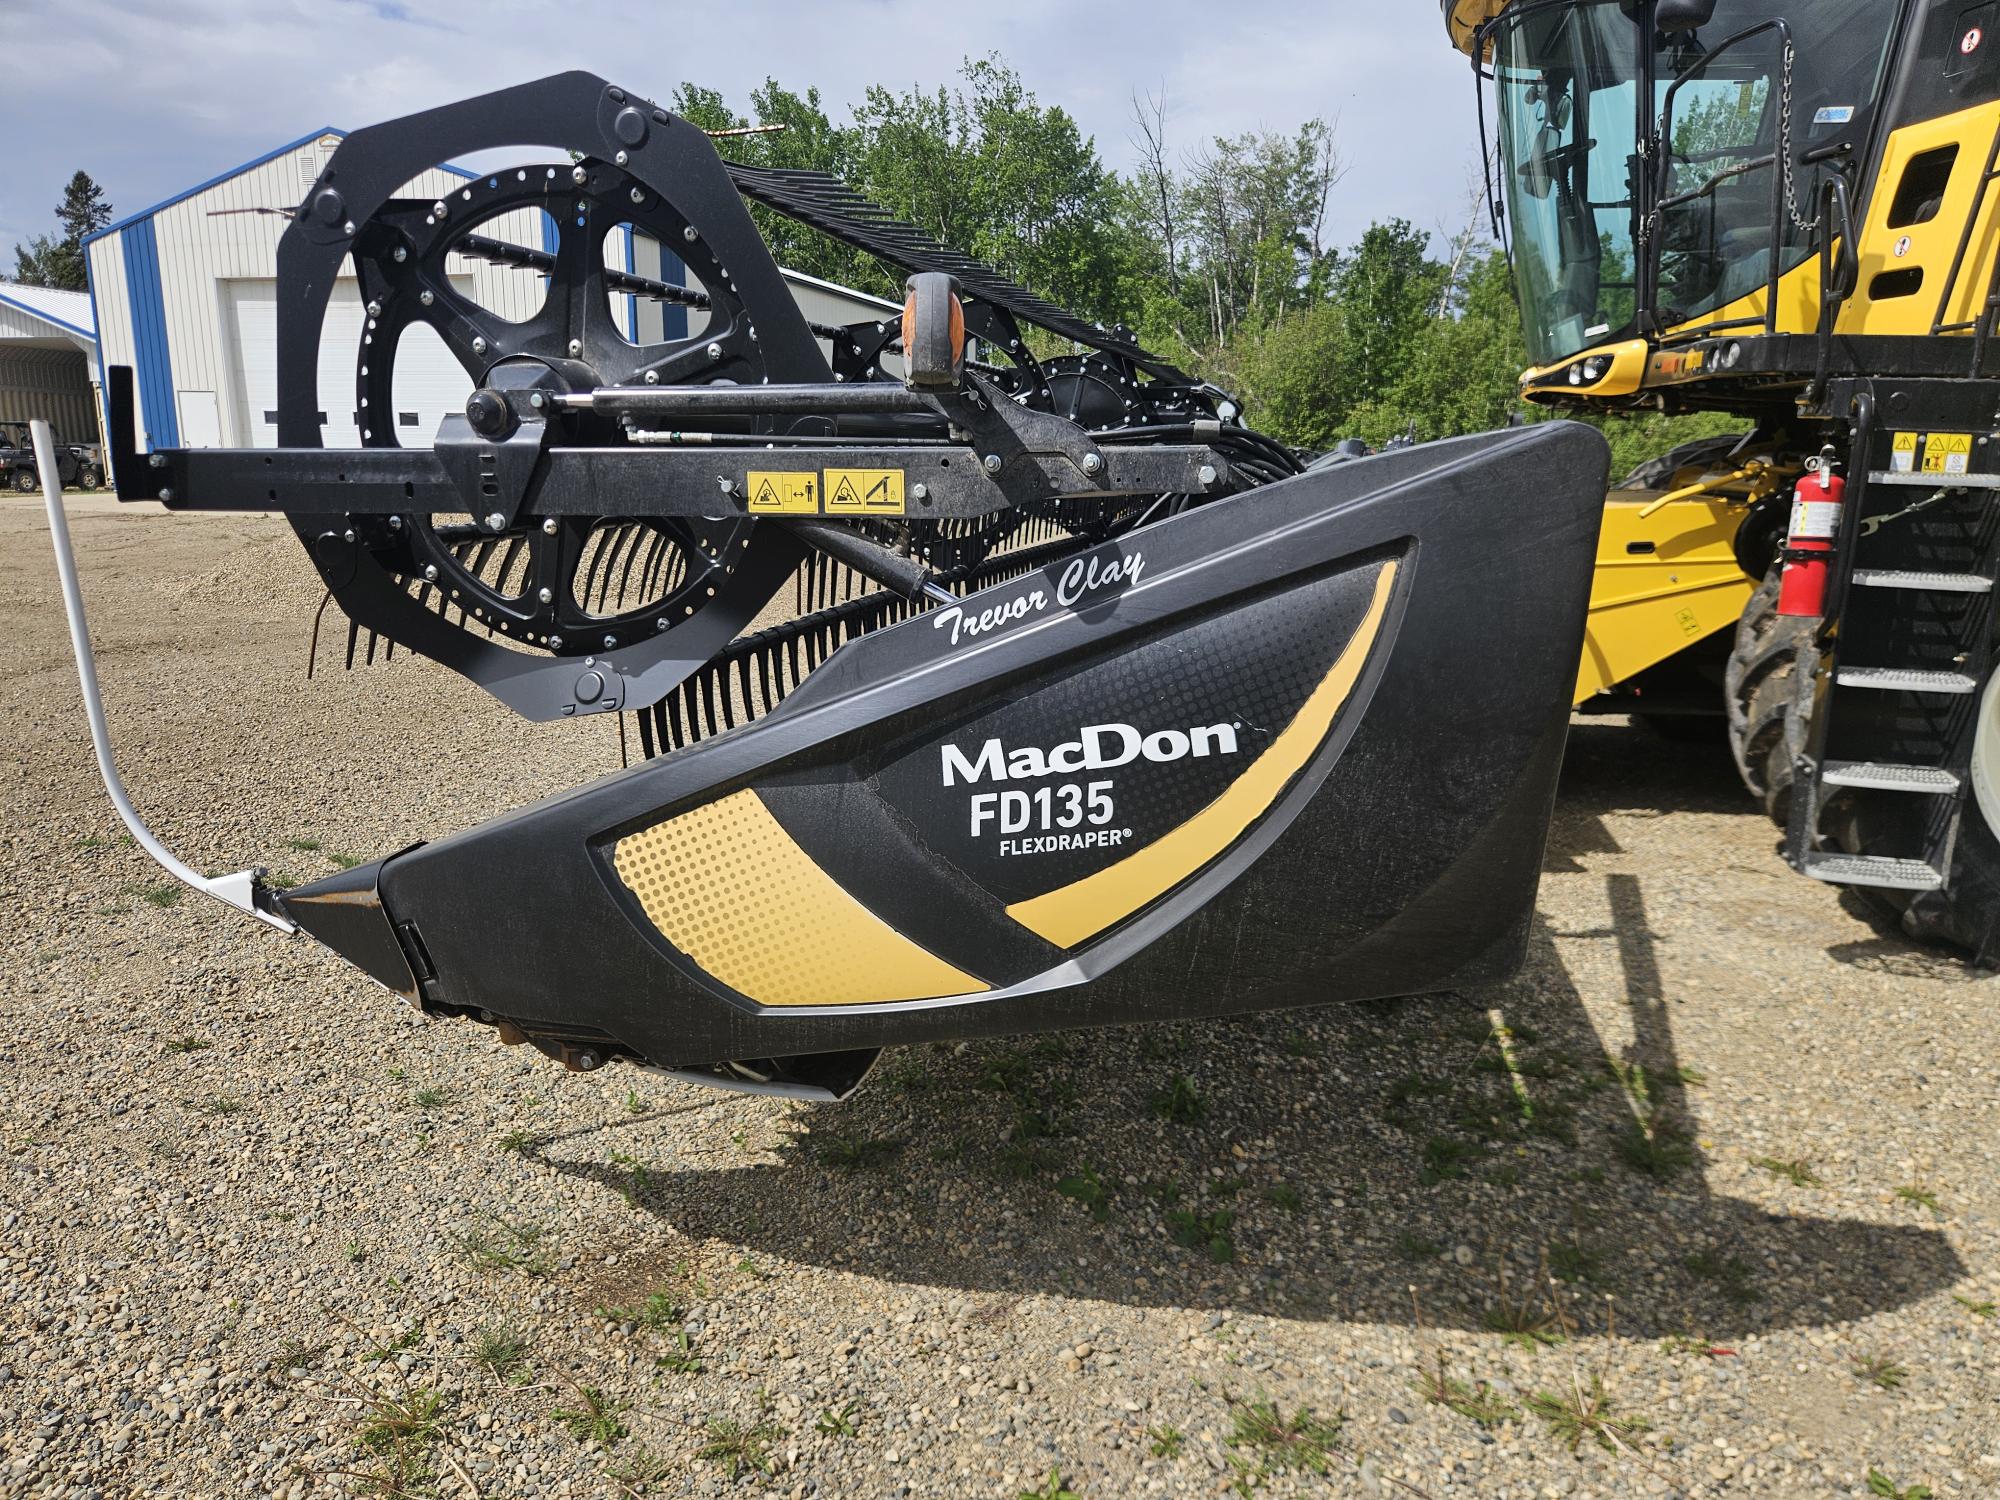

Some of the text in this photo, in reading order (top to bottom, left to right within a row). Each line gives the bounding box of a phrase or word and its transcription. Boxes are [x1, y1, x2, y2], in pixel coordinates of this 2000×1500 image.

[934, 552, 1145, 645] Trevor Clay
[970, 780, 1114, 837] FD135
